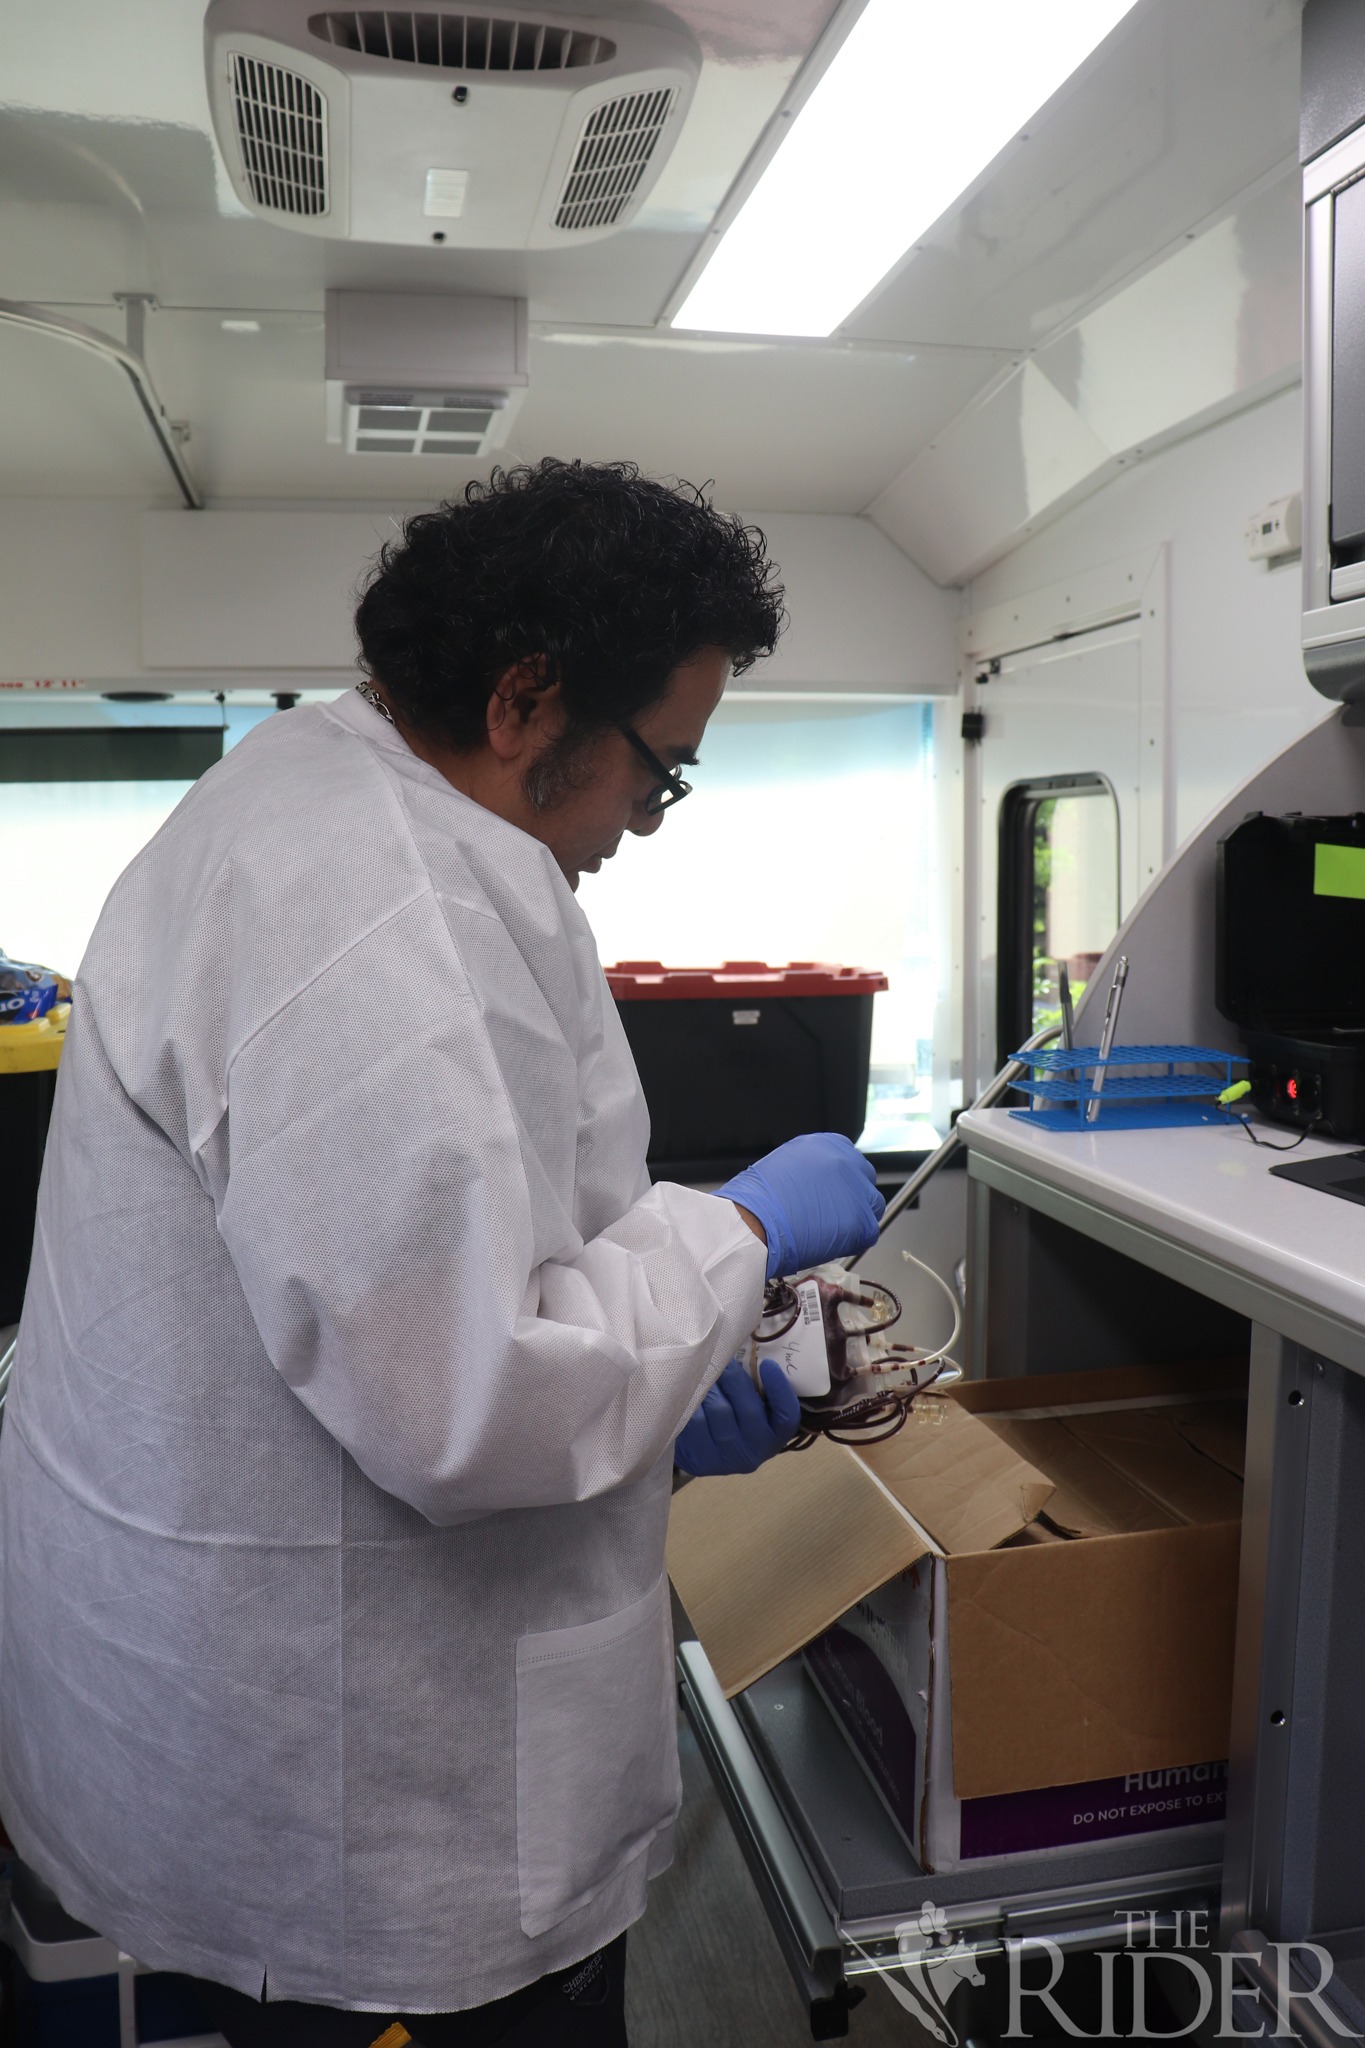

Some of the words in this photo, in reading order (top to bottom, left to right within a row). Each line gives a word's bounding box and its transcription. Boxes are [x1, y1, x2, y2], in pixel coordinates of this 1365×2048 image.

[1124, 1761, 1227, 1793] Human
[1073, 1811, 1094, 1825] DO
[1098, 1807, 1126, 1822] NOT
[1130, 1800, 1181, 1816] EXPOSE
[1185, 1794, 1203, 1807] TO
